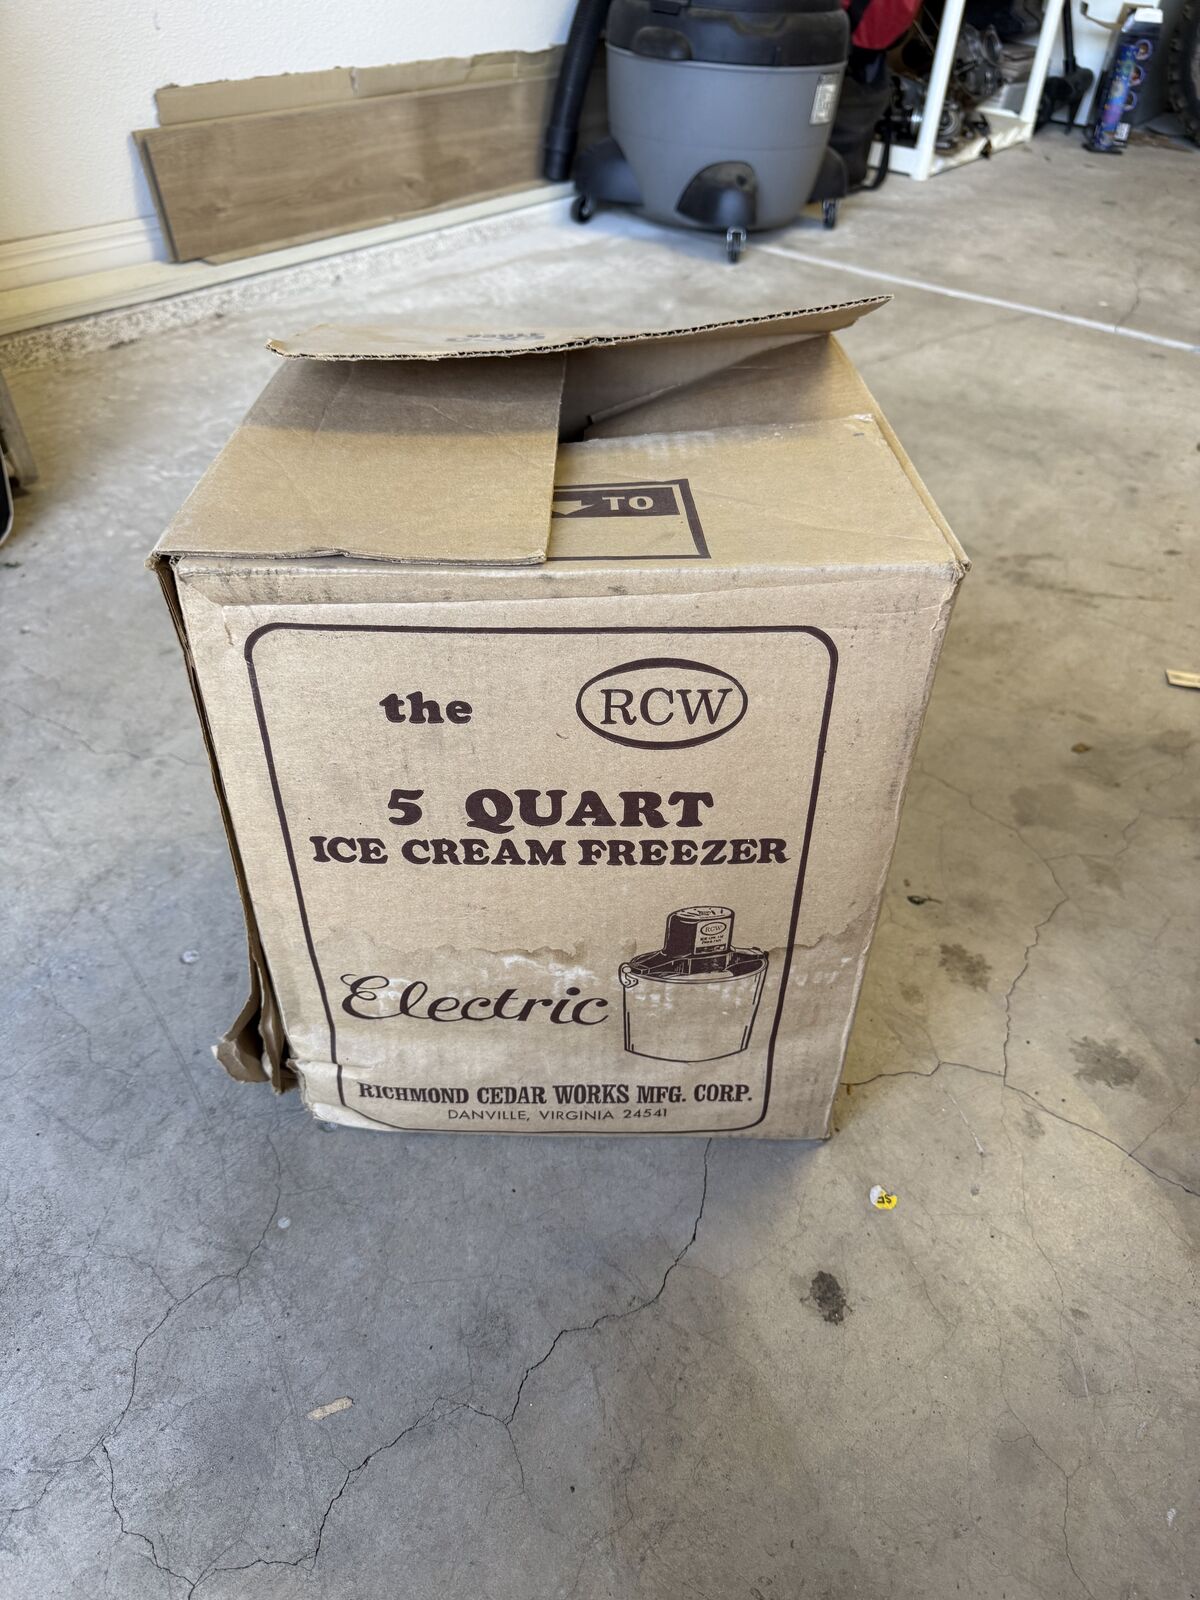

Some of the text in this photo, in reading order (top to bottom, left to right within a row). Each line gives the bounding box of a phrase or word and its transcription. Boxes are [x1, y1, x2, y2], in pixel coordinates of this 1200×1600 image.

[602, 496, 653, 510] TO
[379, 691, 472, 724] the
[600, 688, 733, 726] RCW
[388, 789, 714, 834] 5 QUART
[309, 836, 791, 865] ICE CREAM FREEZER
[340, 974, 609, 1025] Electric
[358, 1082, 752, 1104] RICHMOND CEDAR WORKS MFG. CORP.
[448, 1108, 668, 1122] DANVILLE, VIRGINIA 24541
